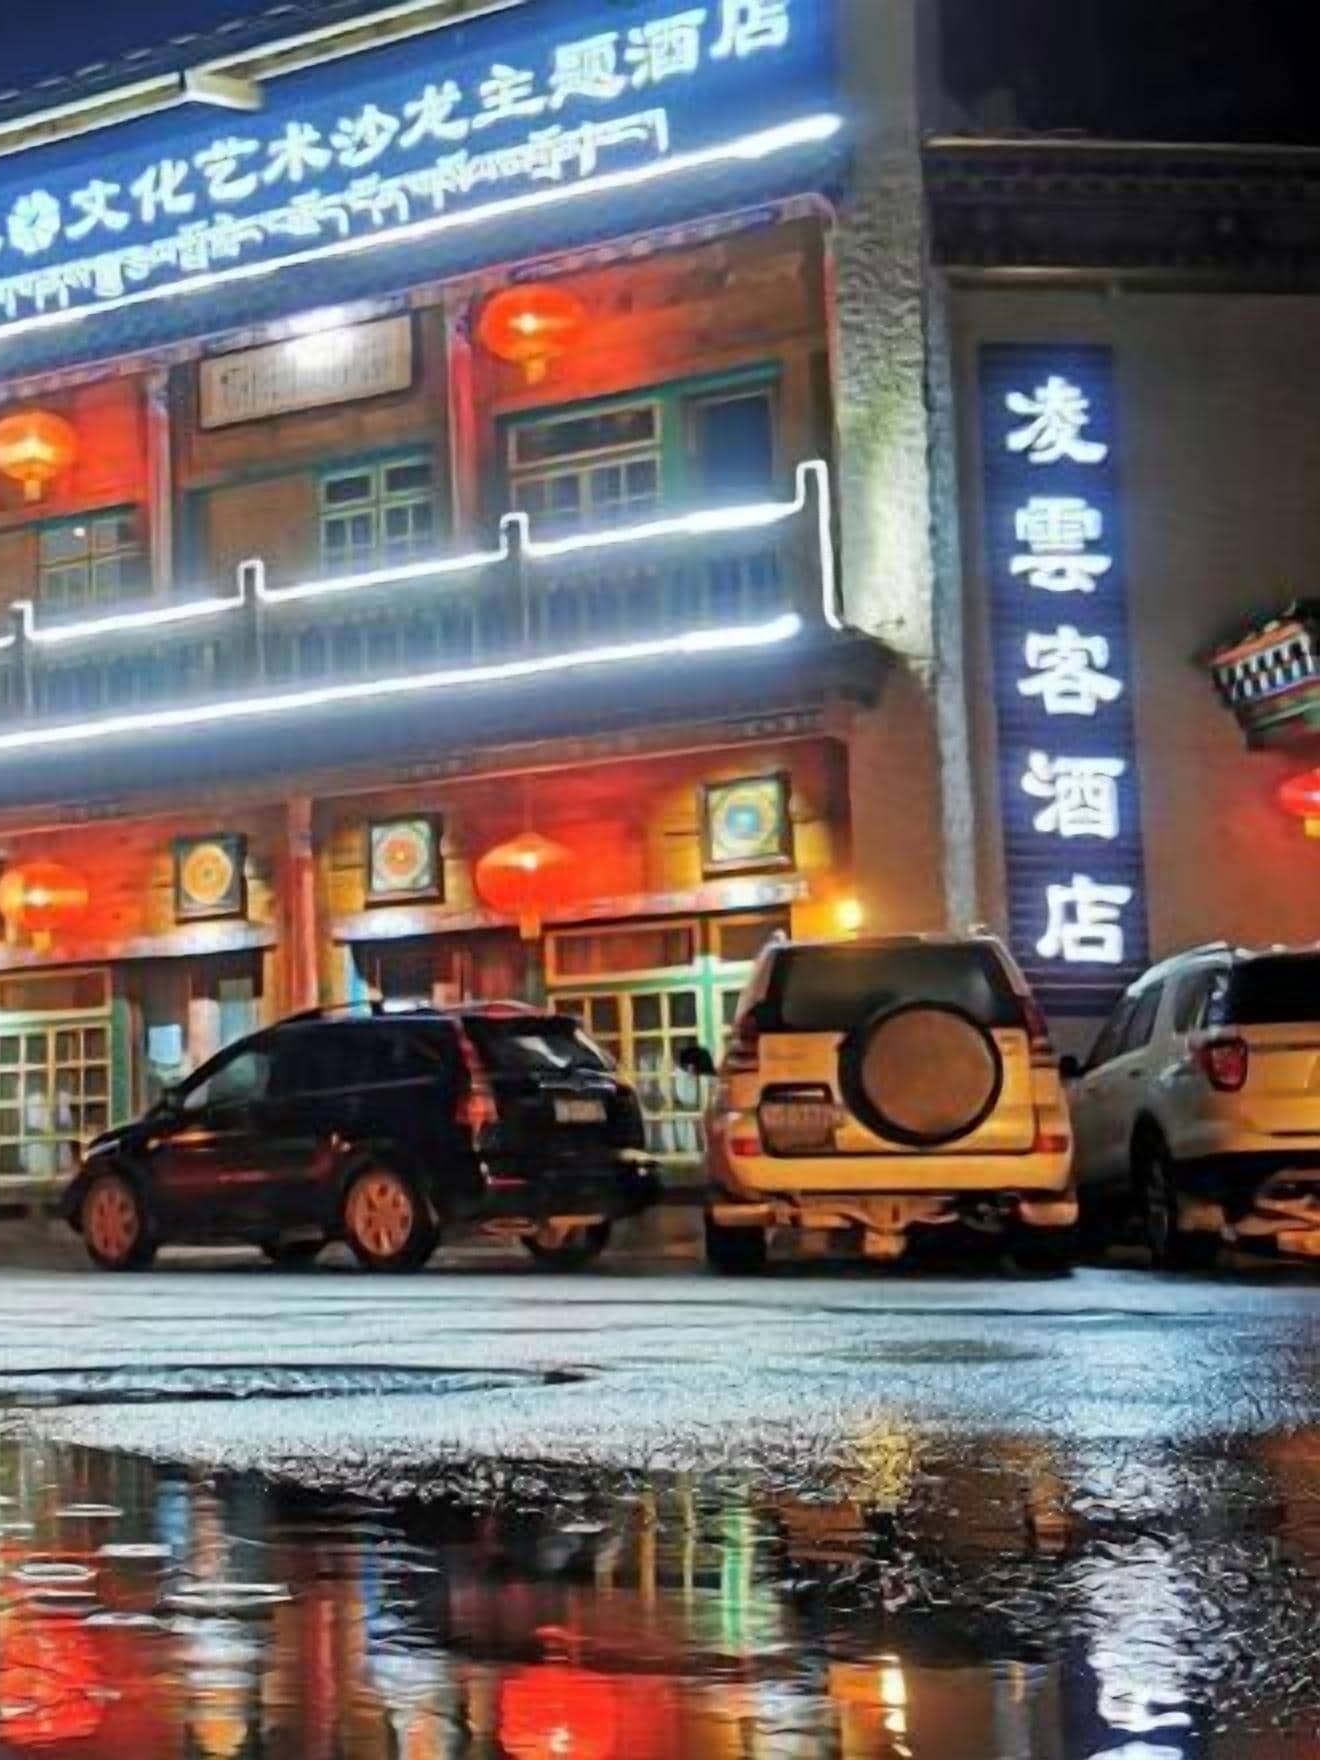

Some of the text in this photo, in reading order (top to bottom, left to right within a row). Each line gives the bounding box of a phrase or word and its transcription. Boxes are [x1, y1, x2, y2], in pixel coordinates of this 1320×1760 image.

[1005, 375, 1133, 964] 凌雲客酒店
